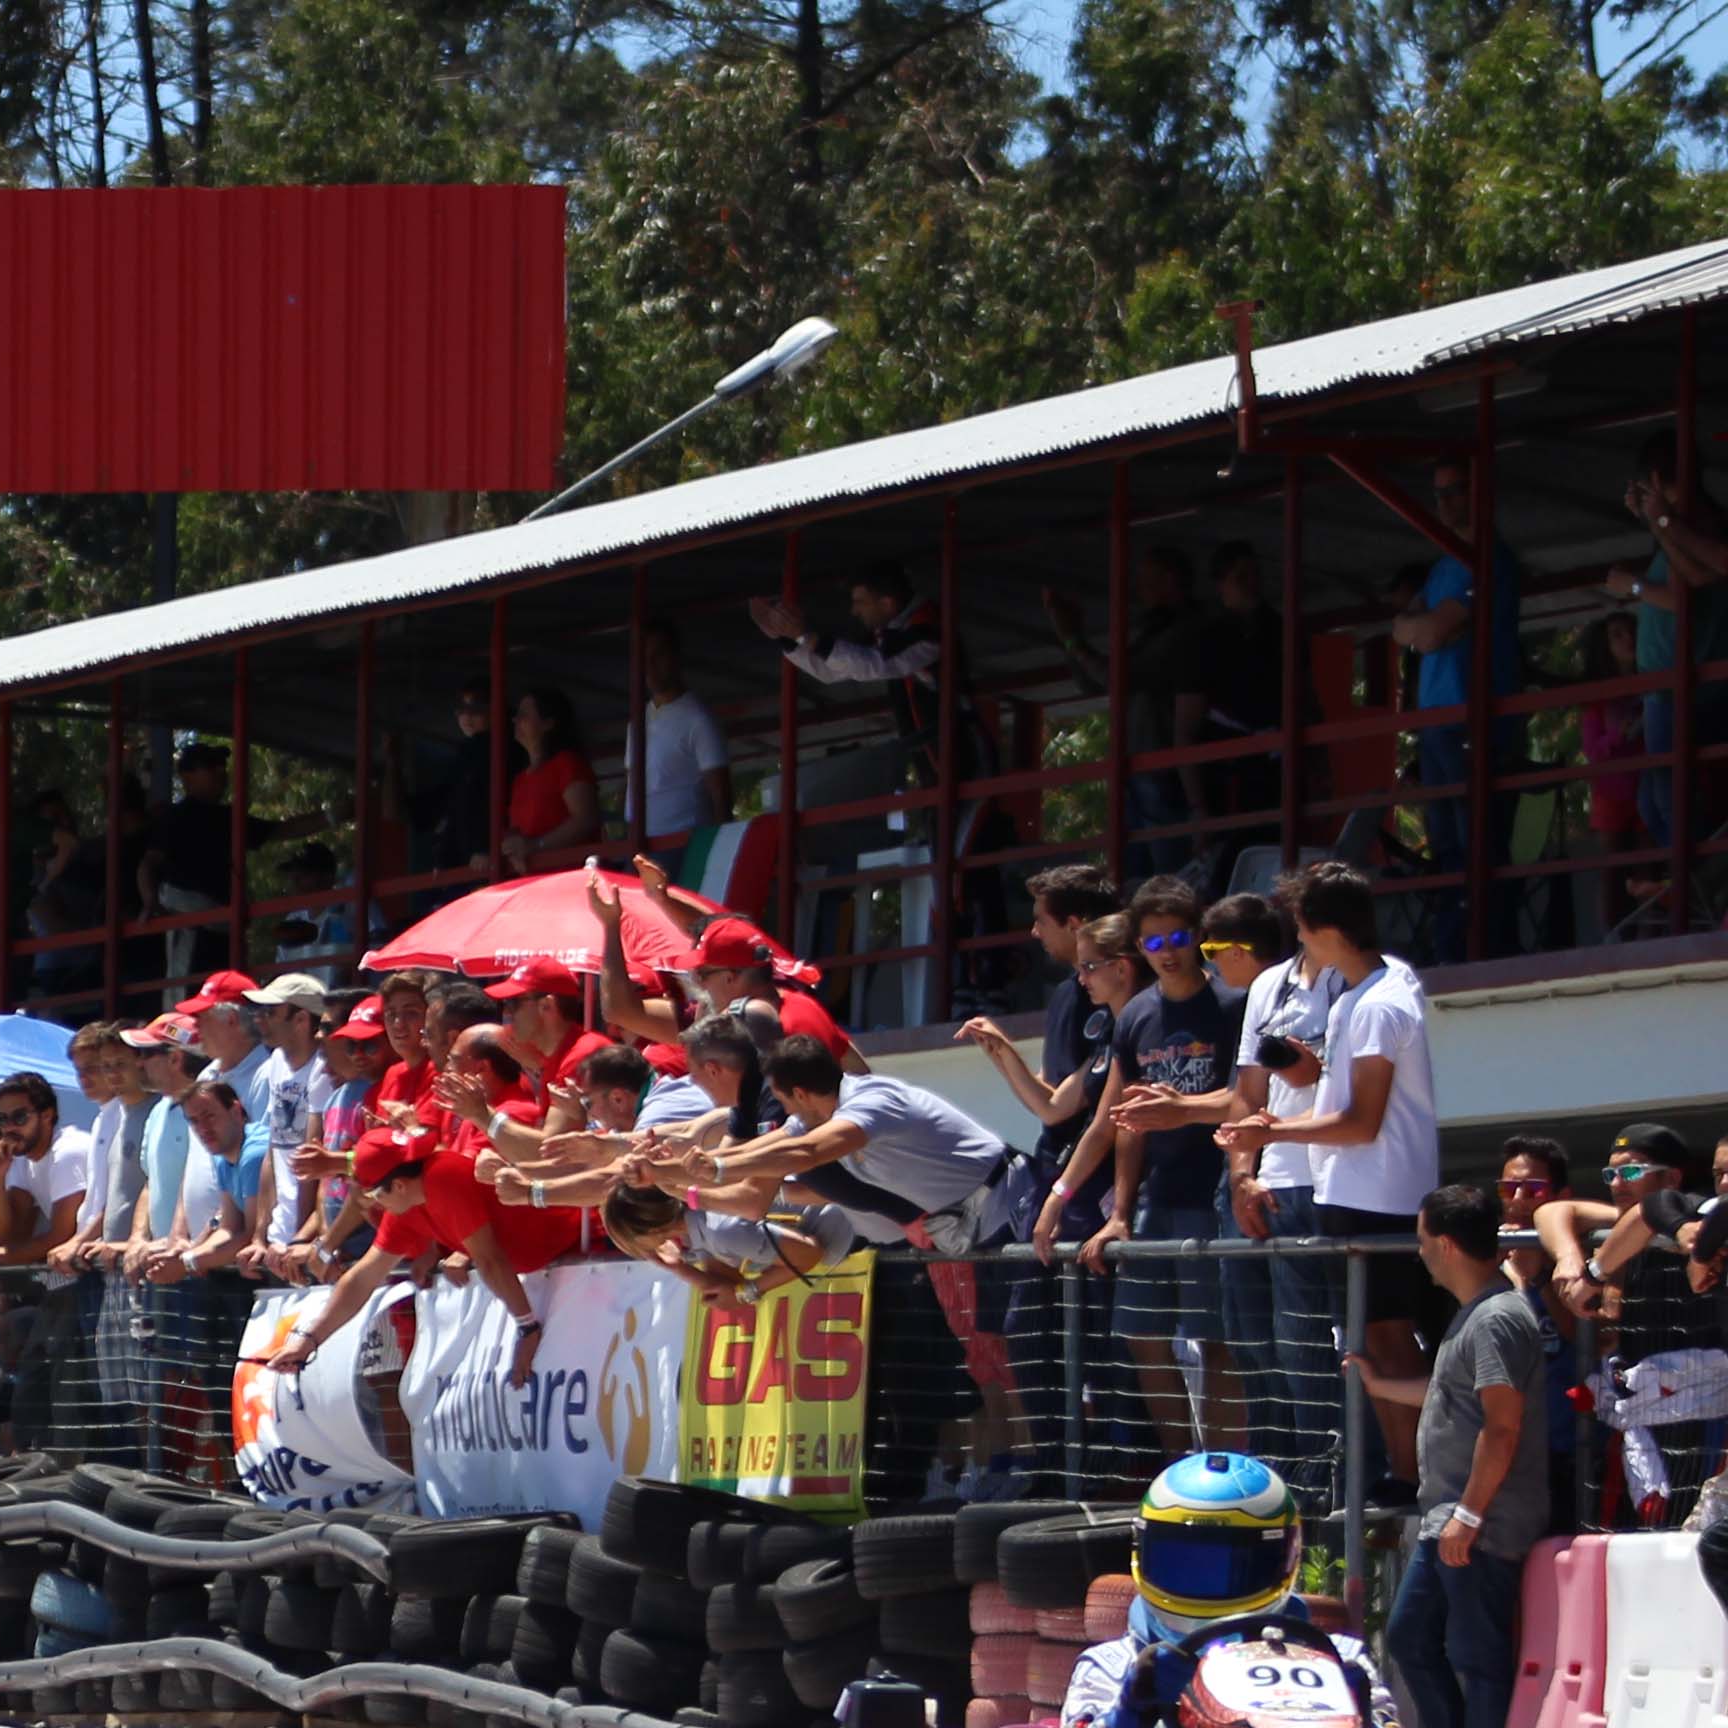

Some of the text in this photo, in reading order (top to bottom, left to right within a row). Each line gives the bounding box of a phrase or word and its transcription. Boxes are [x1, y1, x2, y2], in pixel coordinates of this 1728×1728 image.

[696, 1289, 864, 1405] GAS
[691, 1431, 859, 1473] RACING TEAM
[1247, 1664, 1324, 1688] 90
